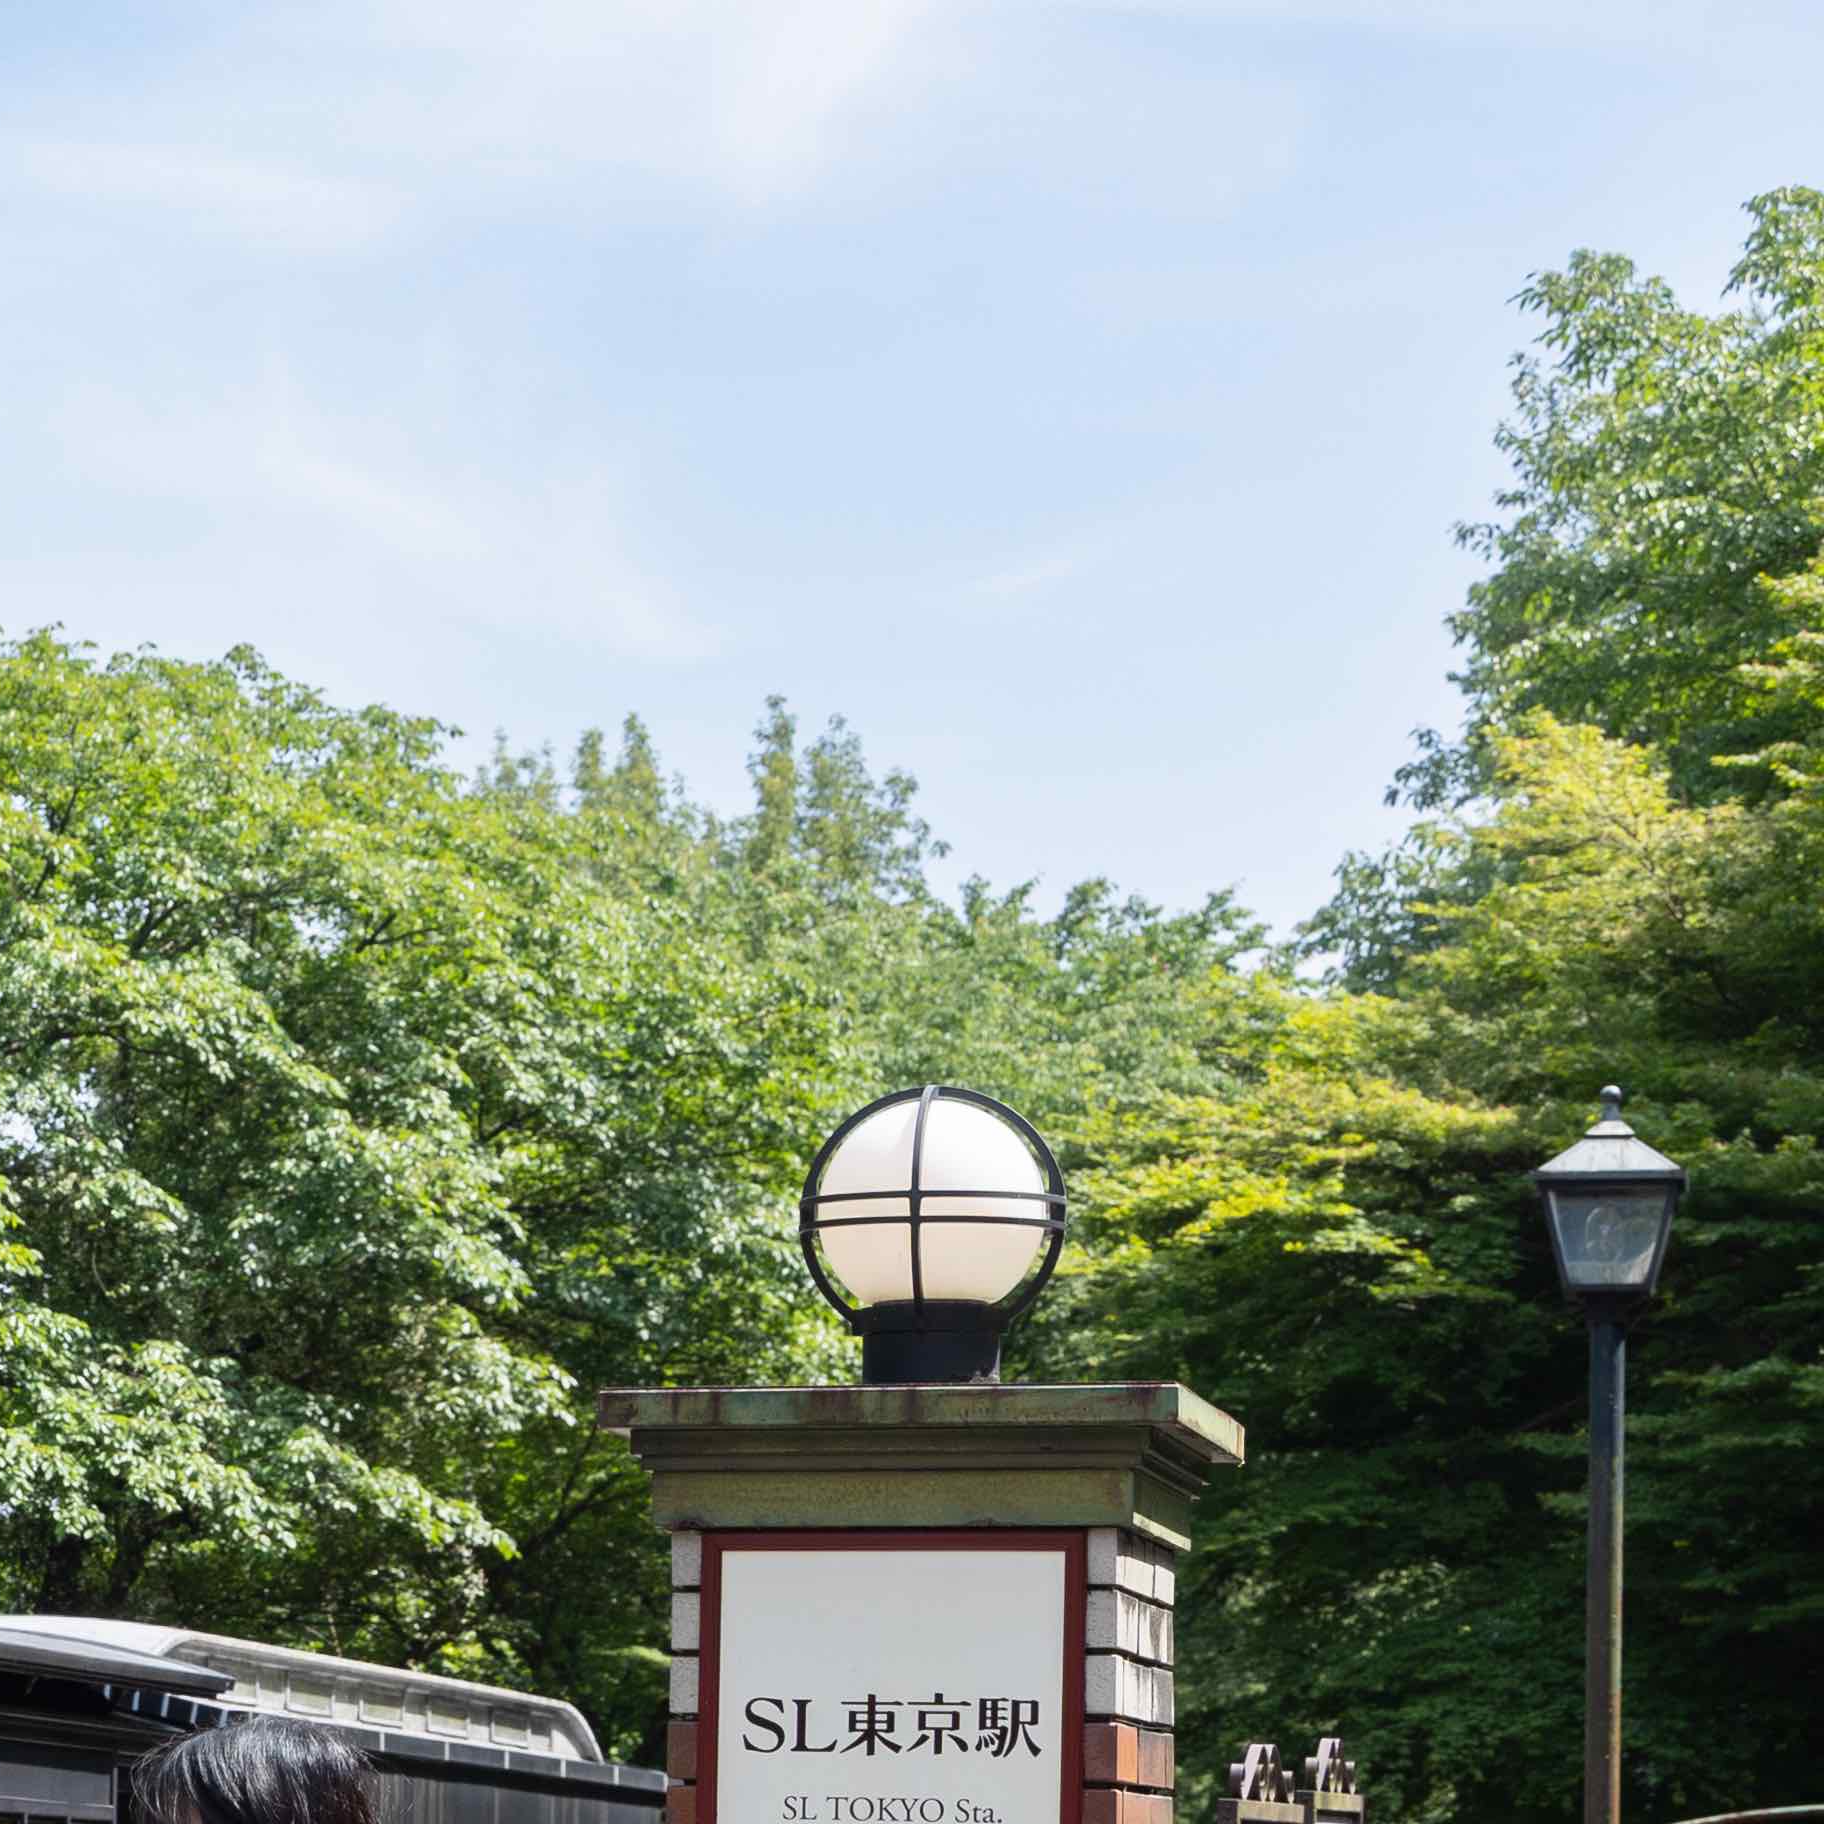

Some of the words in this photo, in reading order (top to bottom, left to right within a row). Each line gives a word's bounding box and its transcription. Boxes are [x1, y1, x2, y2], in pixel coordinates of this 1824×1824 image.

[743, 1693, 1042, 1757] SL東京駅
[782, 1796, 817, 1822] SL
[826, 1796, 944, 1823] TOKYO
[954, 1798, 1003, 1824] Sta.
